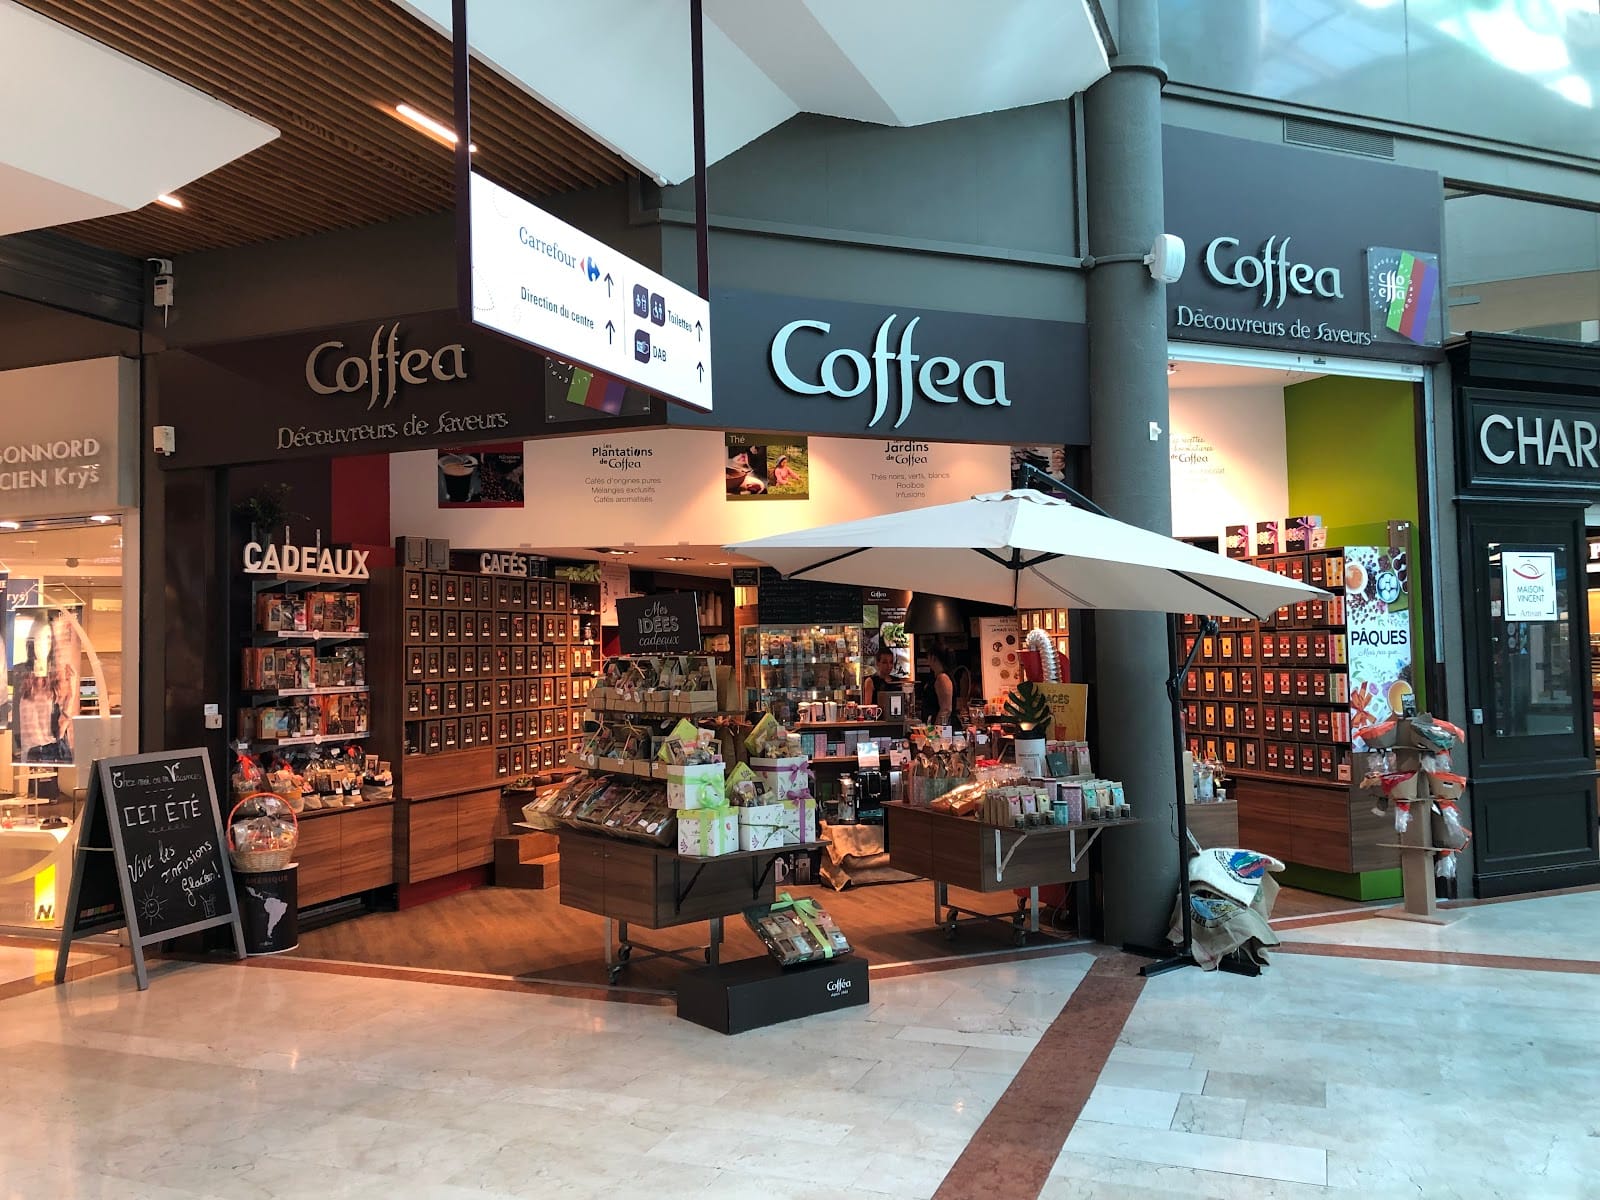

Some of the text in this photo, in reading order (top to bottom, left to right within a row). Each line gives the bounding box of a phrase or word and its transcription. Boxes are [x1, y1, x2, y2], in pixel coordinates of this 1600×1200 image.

[519, 226, 577, 269] Carrefour
[1206, 234, 1344, 310] Coffea
[521, 286, 595, 329] Direction du centre
[667, 309, 693, 333] Toilettes
[1176, 305, 1371, 346] Découvreurs de Saveurs
[652, 345, 667, 362] DAB
[305, 321, 468, 411] Coffea
[771, 313, 1012, 429] Coffea
[276, 411, 508, 450] Découvreurs de Saveurs
[729, 435, 745, 444] Thé
[884, 440, 929, 453] Jardins
[1480, 414, 1600, 468] CHAR
[0, 438, 100, 464] ONNORD
[592, 446, 653, 457] Plantations
[895, 452, 928, 466] Coffea
[1178, 453, 1209, 464] Coffea
[608, 457, 641, 471] Coffea
[0, 467, 100, 490] CIEN Krys
[584, 477, 605, 485] Cafés
[593, 495, 614, 503] Cafés
[243, 542, 370, 578] CADEAUX
[480, 552, 527, 576] CAFÉS
[7, 592, 27, 604] rys
[1516, 585, 1545, 594] MAISON
[1516, 594, 1545, 602] VINCENT
[644, 600, 668, 617] Mes
[1520, 609, 1542, 617] Artisan
[639, 632, 680, 648] cadeaux
[1351, 627, 1408, 647] PÂQUES
[1047, 693, 1070, 704] ACÉS
[123, 793, 202, 827] CET ÉTÉ
[127, 854, 154, 883] Vive
[826, 978, 852, 993] Cofféa
